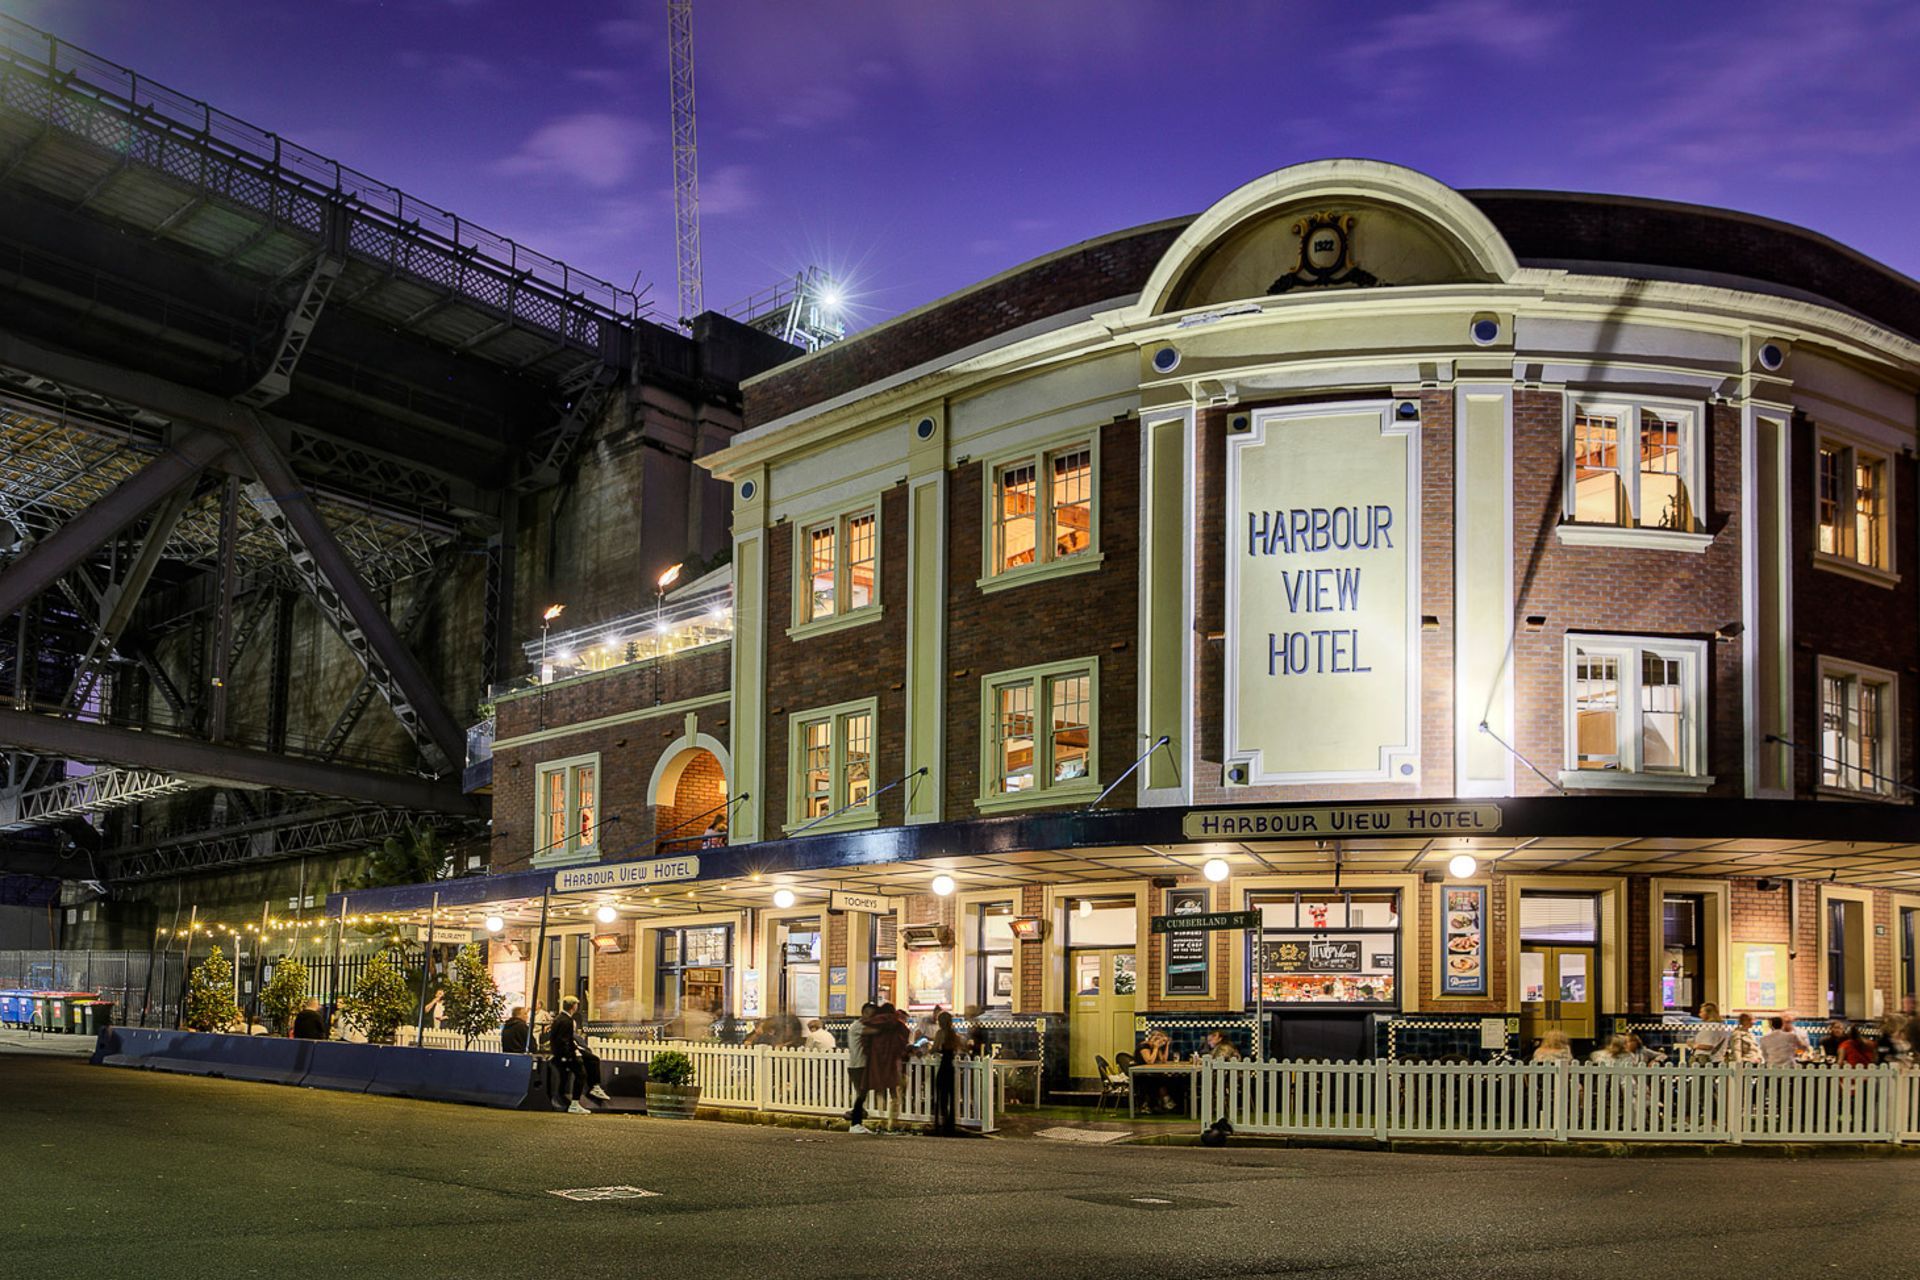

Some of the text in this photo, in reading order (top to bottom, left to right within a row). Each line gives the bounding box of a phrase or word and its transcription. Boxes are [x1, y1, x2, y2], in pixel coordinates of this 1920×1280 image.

[1248, 505, 1394, 557] HARBOUR
[1281, 568, 1361, 613] VIEW
[1268, 629, 1372, 676] HOTEL
[1202, 808, 1484, 834] HARBOUR VIEW HOTEL
[564, 862, 690, 888] HARBOUR VIEW HOTEL
[844, 896, 878, 909] TOOHEYS
[1167, 915, 1245, 929] CUMBERLAND ST
